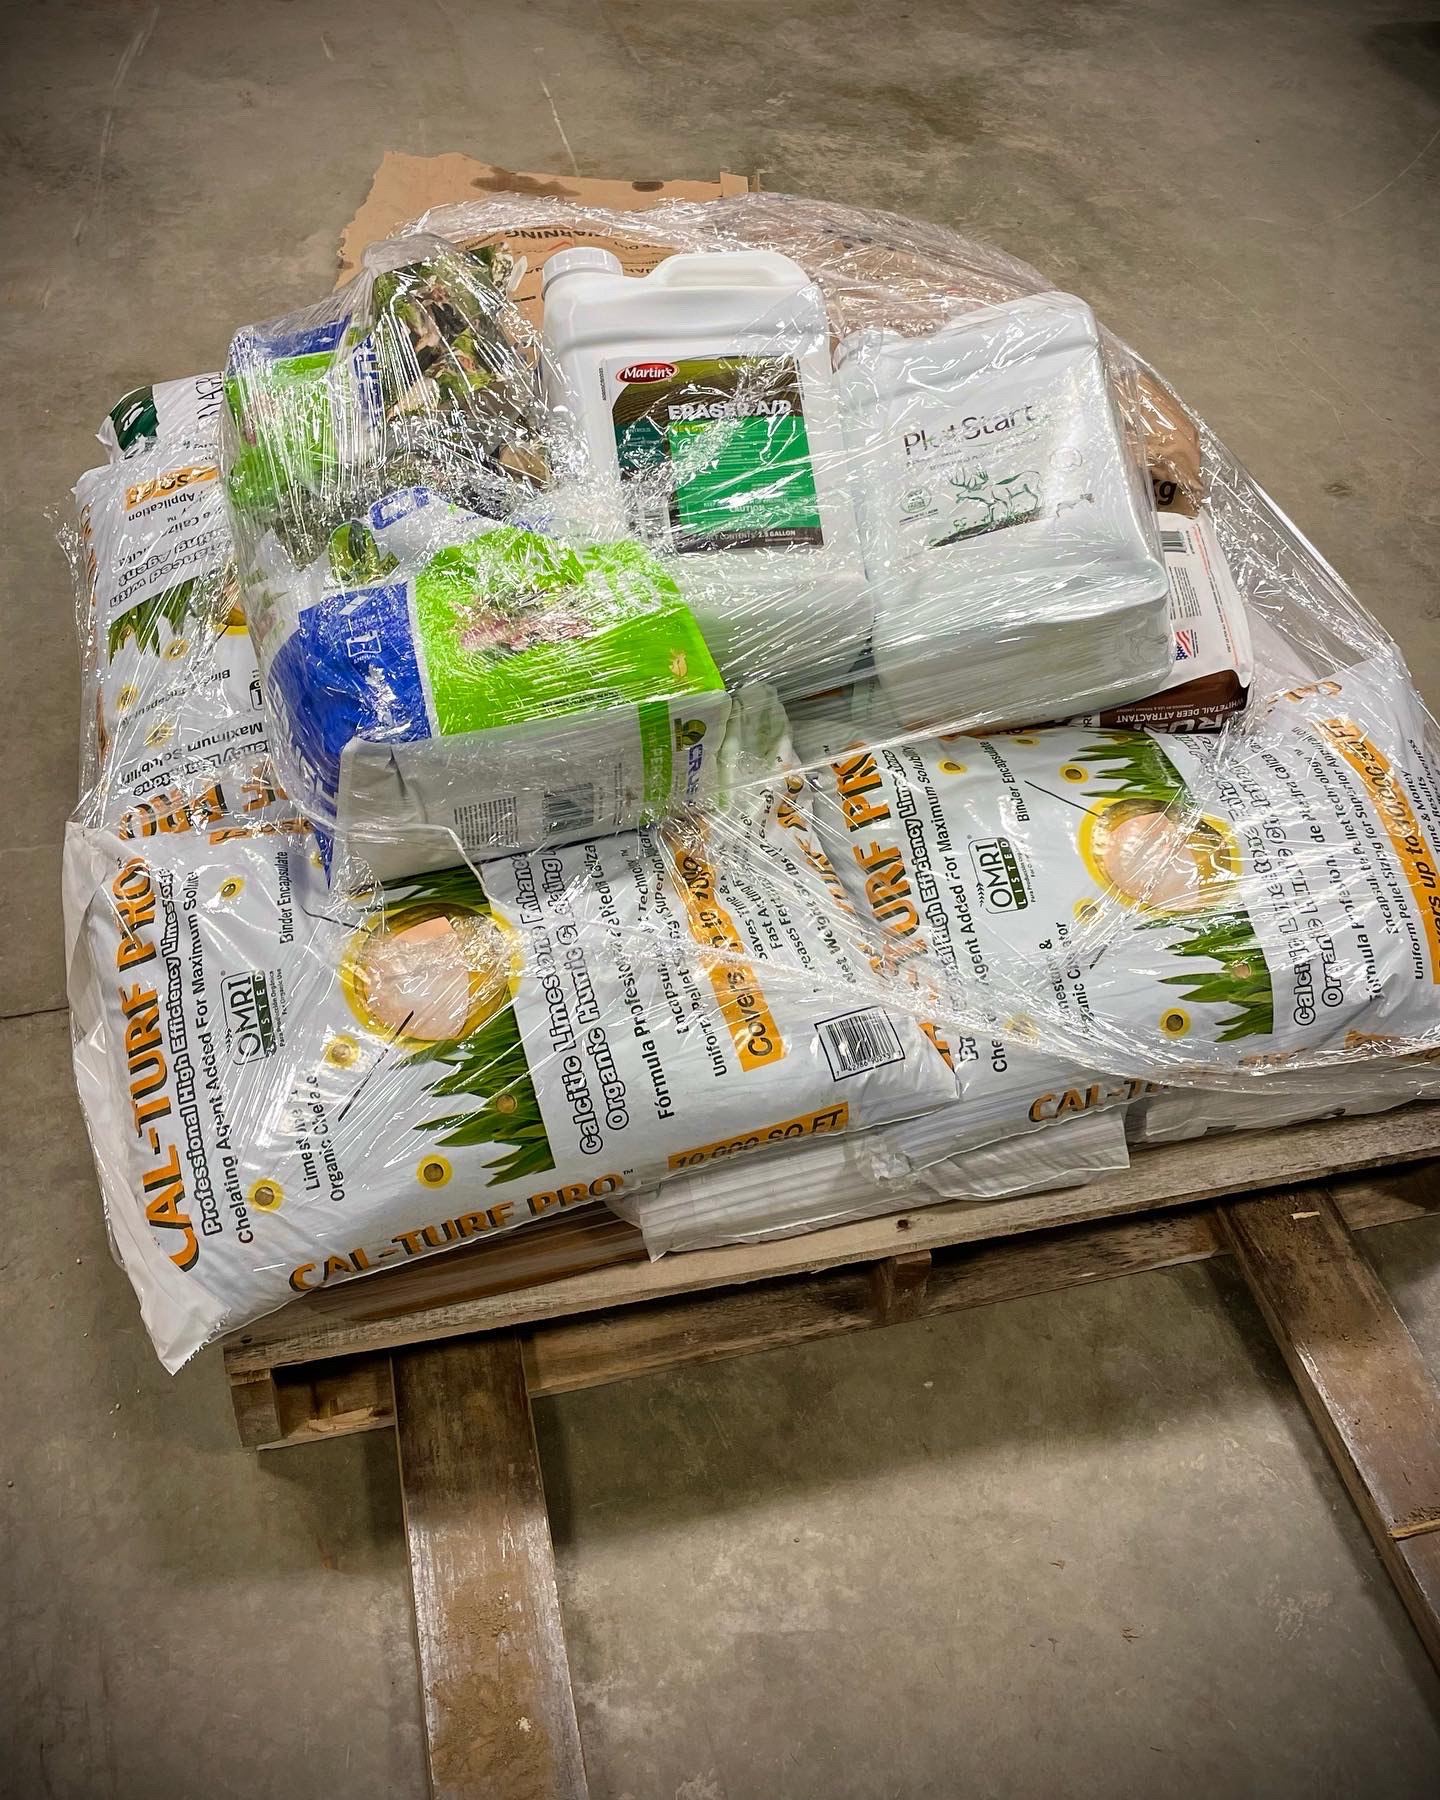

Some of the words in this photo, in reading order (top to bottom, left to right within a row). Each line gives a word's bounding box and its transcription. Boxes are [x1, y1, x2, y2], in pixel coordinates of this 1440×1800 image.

[623, 365, 674, 380] Martin's
[127, 491, 195, 522] Application
[188, 721, 263, 753] Maximum
[1115, 710, 1174, 724] ATTRACTANT
[1176, 707, 1200, 719] DEER
[1261, 752, 1291, 780] Caliza
[1401, 770, 1426, 811] Money
[925, 786, 952, 854] Maximum
[1007, 785, 1030, 824] Binder
[1362, 820, 1377, 840] for
[905, 817, 939, 903] Efficiency
[1310, 824, 1326, 844] de
[1405, 835, 1424, 855] to
[276, 851, 293, 906] Encapsulate
[975, 841, 1013, 908] OMRI
[1000, 841, 1027, 905] LISTED
[1386, 880, 1412, 919] Pellet
[1415, 860, 1437, 890] up
[112, 856, 158, 973] PRO
[279, 906, 295, 945] Binder
[950, 883, 976, 935] Added
[187, 913, 206, 996] Maximum
[761, 921, 784, 951] Fast
[1038, 938, 1053, 950] &
[1405, 922, 1424, 980] Uniform
[165, 957, 189, 1054] Efficiency
[255, 971, 275, 1055] ISTED
[564, 947, 601, 1026] Humic
[195, 998, 209, 1029] For
[227, 976, 261, 1058] OMRI
[173, 1053, 197, 1105] High
[197, 1031, 221, 1090] Added
[587, 1026, 630, 1131] Organic
[640, 1039, 675, 1121] Fórmula
[119, 981, 200, 1273] CAL-TURF
[562, 1054, 603, 1156] Calcitic
[810, 1107, 846, 1133] FT
[179, 1106, 223, 1236] Professional
[320, 1138, 346, 1203] Organic
[221, 1155, 254, 1244] Chelating
